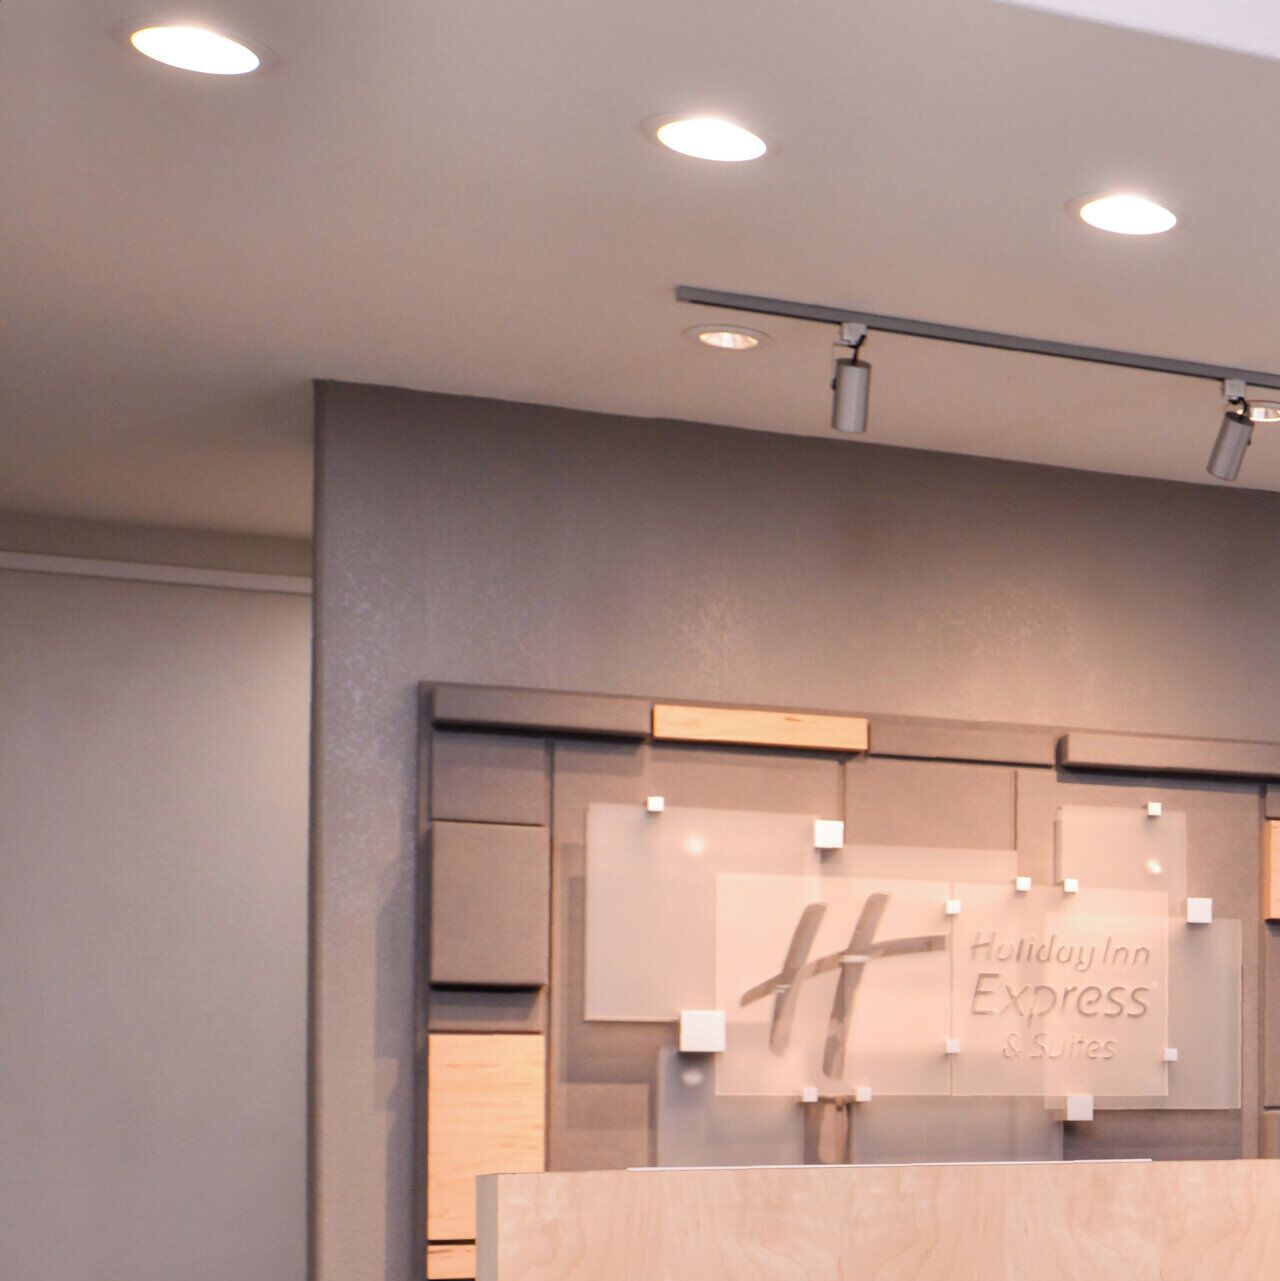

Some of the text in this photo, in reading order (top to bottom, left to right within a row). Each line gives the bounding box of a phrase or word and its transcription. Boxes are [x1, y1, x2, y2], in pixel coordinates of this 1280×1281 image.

[969, 932, 1150, 971] Holiday Inn
[971, 972, 1151, 1028] Express
[1002, 1032, 1116, 1060] & Suites
